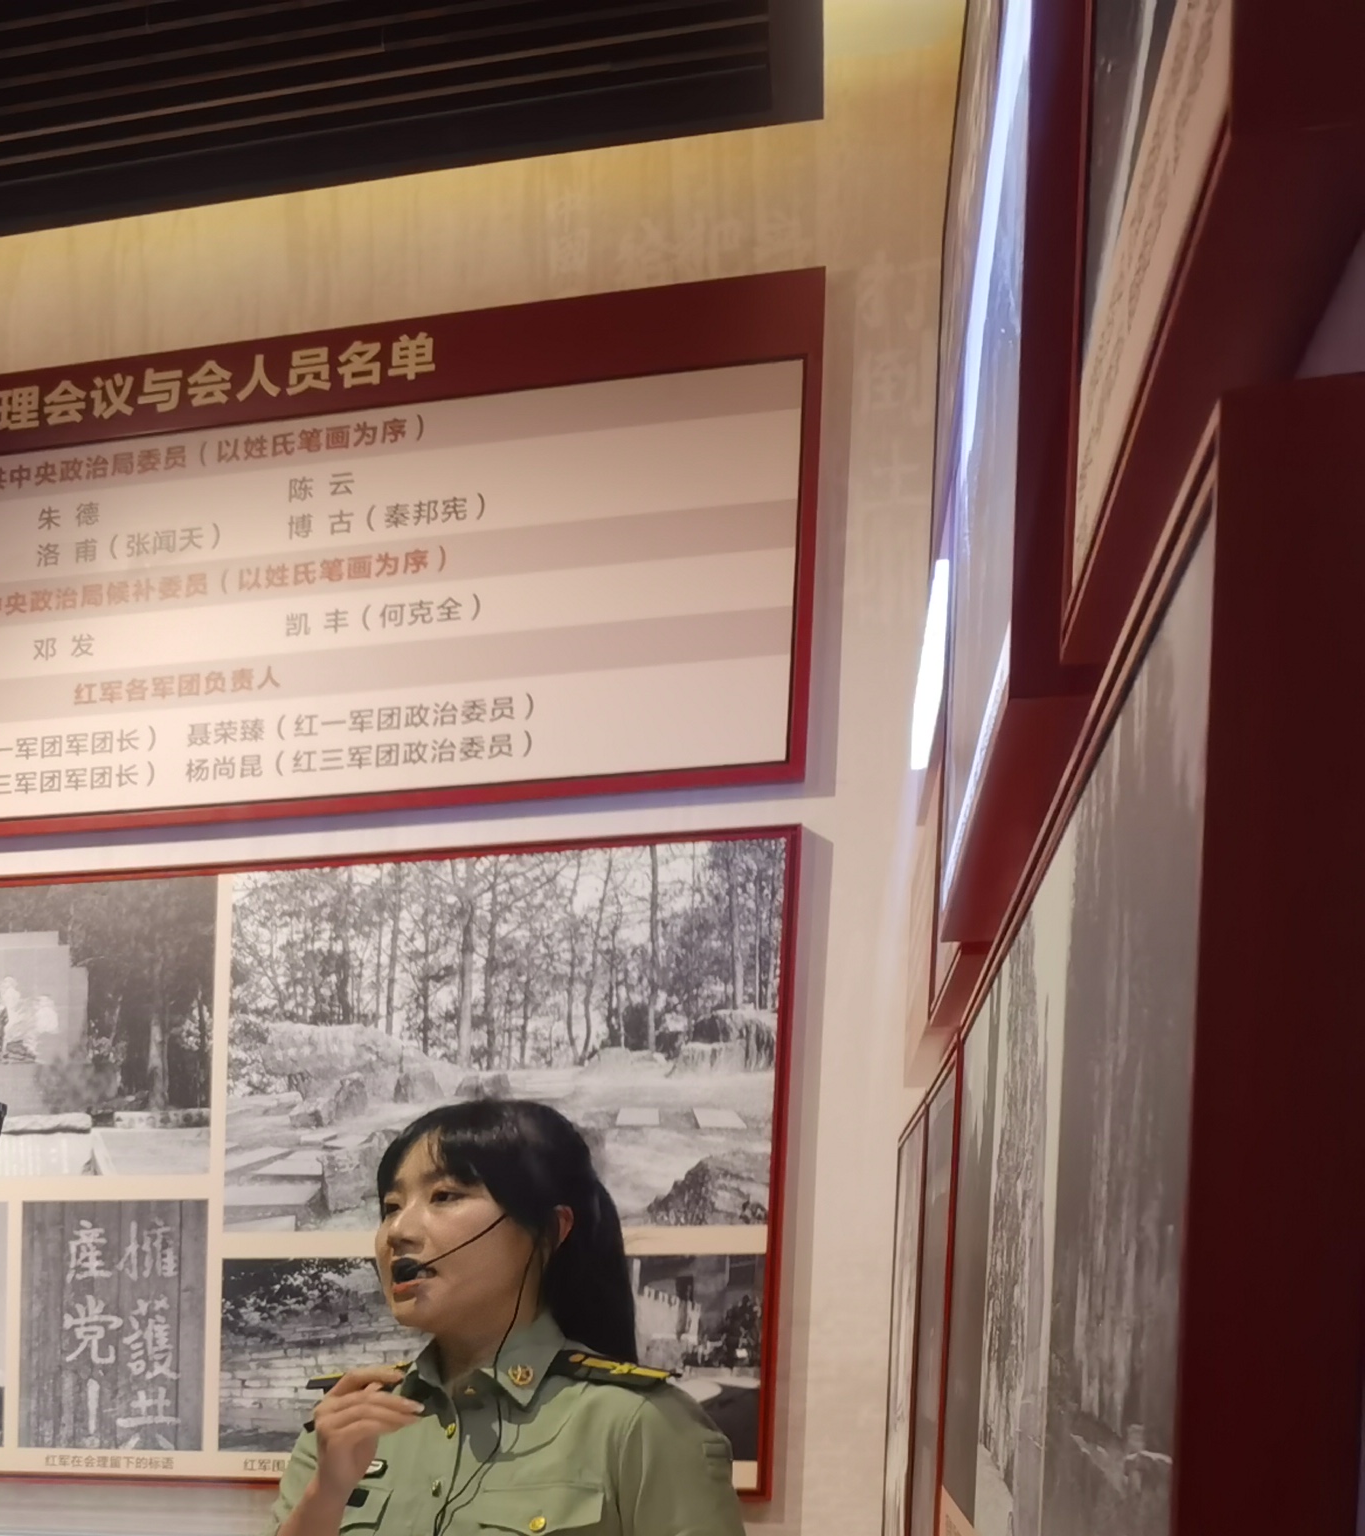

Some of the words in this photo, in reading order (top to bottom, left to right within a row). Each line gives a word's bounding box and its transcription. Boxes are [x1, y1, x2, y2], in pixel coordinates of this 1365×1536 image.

[73, 665, 281, 707] 红军各军团负责人
[44, 1454, 175, 1470] 红军在会理留下的标语
